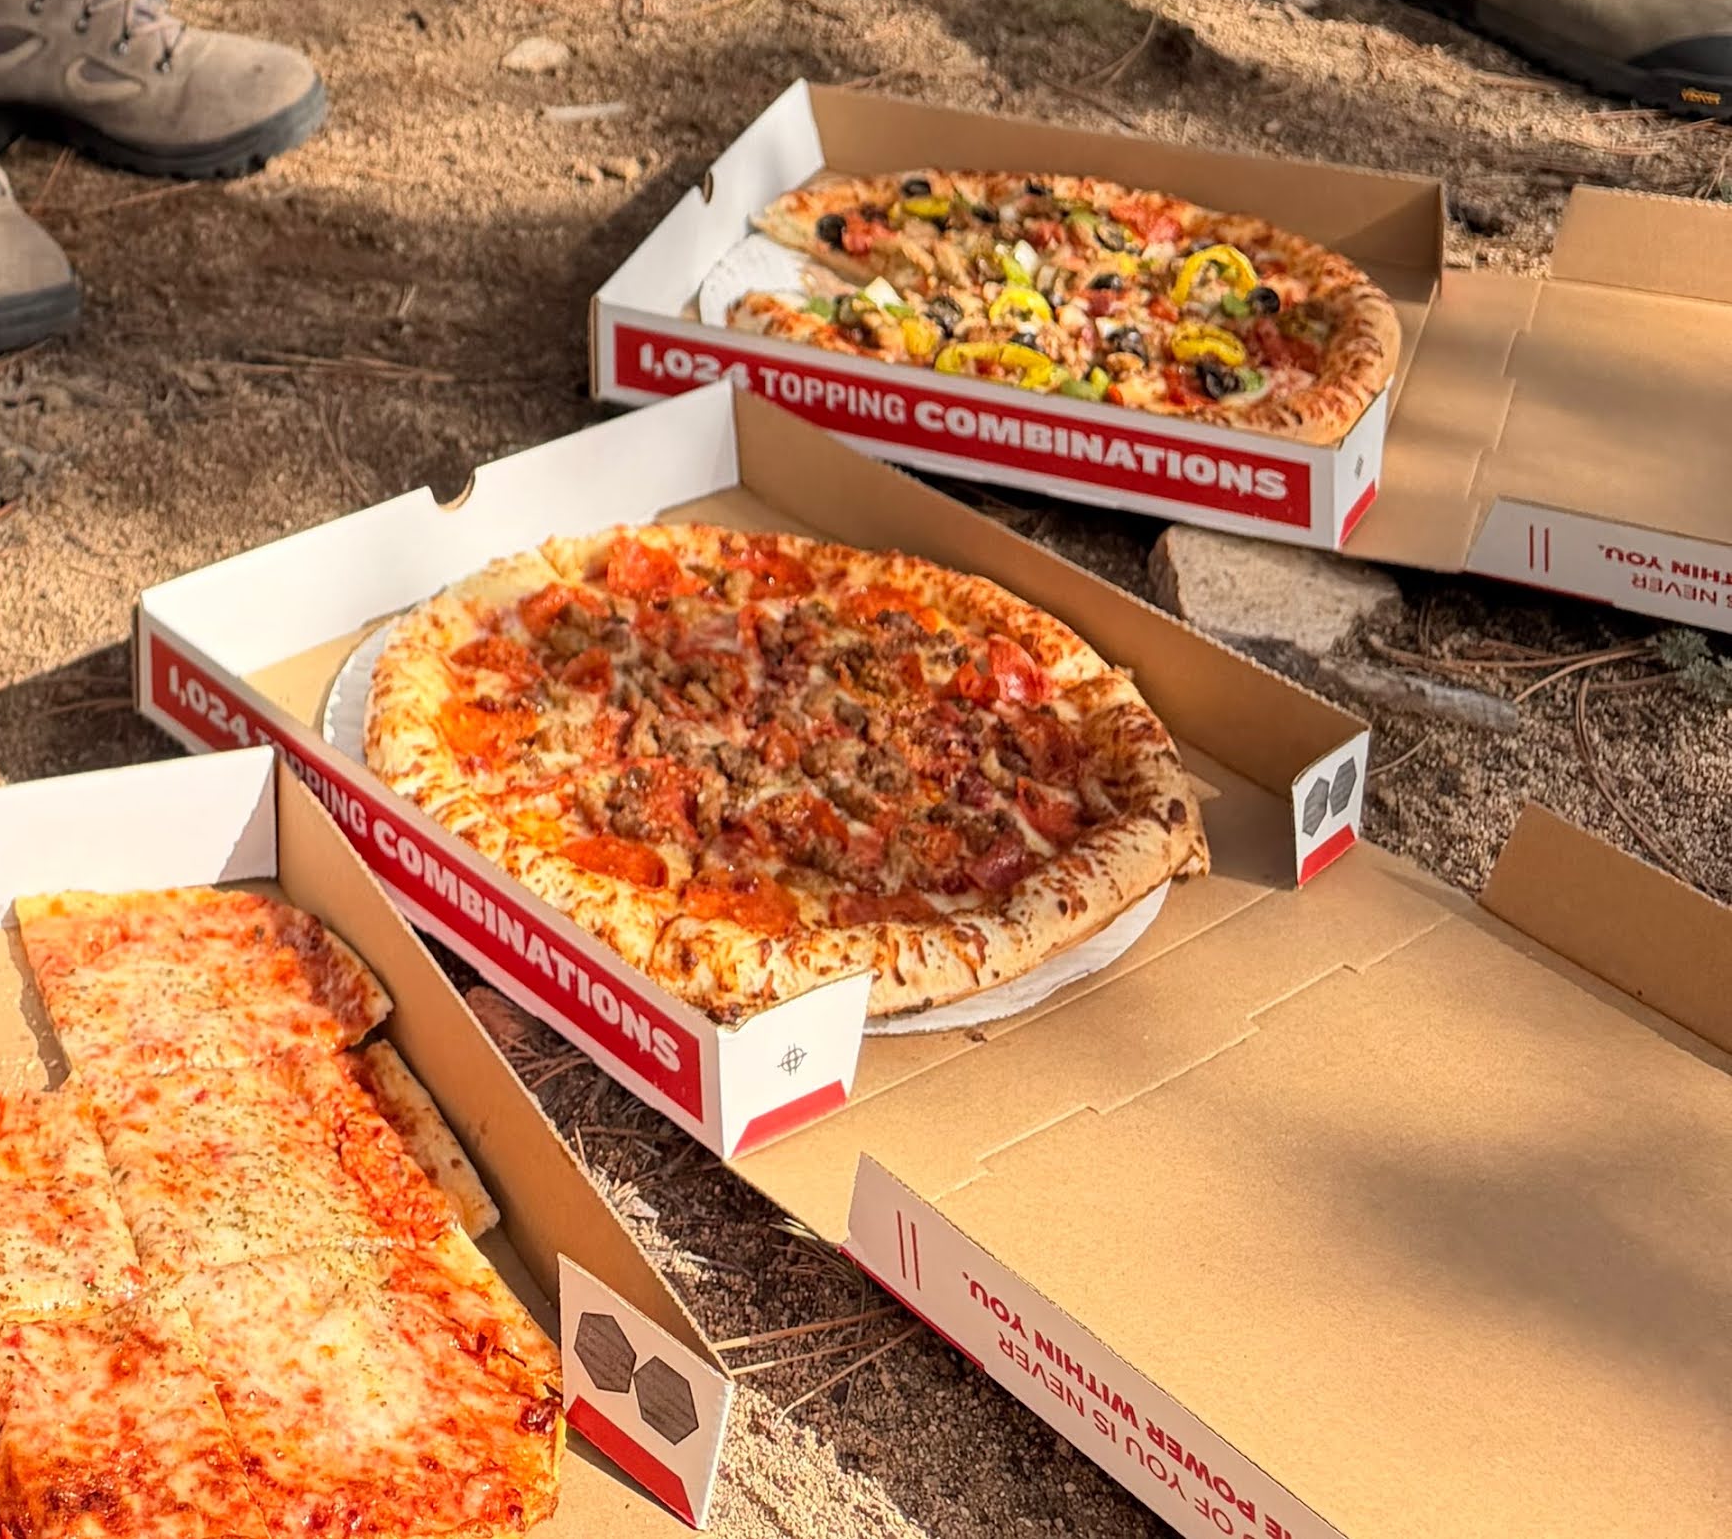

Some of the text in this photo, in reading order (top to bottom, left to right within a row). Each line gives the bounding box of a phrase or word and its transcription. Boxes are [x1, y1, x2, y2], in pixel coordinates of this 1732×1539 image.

[758, 365, 908, 424] TOPPING
[913, 399, 1288, 501] COMBINATIONS
[1631, 572, 1717, 606] NEVER
[1671, 558, 1732, 589] THIN
[168, 664, 251, 748] 1,024
[372, 817, 682, 1074] COMBINATIONS
[961, 1270, 1257, 1526] POWER WITHIN YOU.
[997, 1329, 1086, 1418] NEVER
[1091, 1408, 1117, 1443] IS
[1125, 1436, 1187, 1502] YOU
[1193, 1496, 1234, 1536] OF
